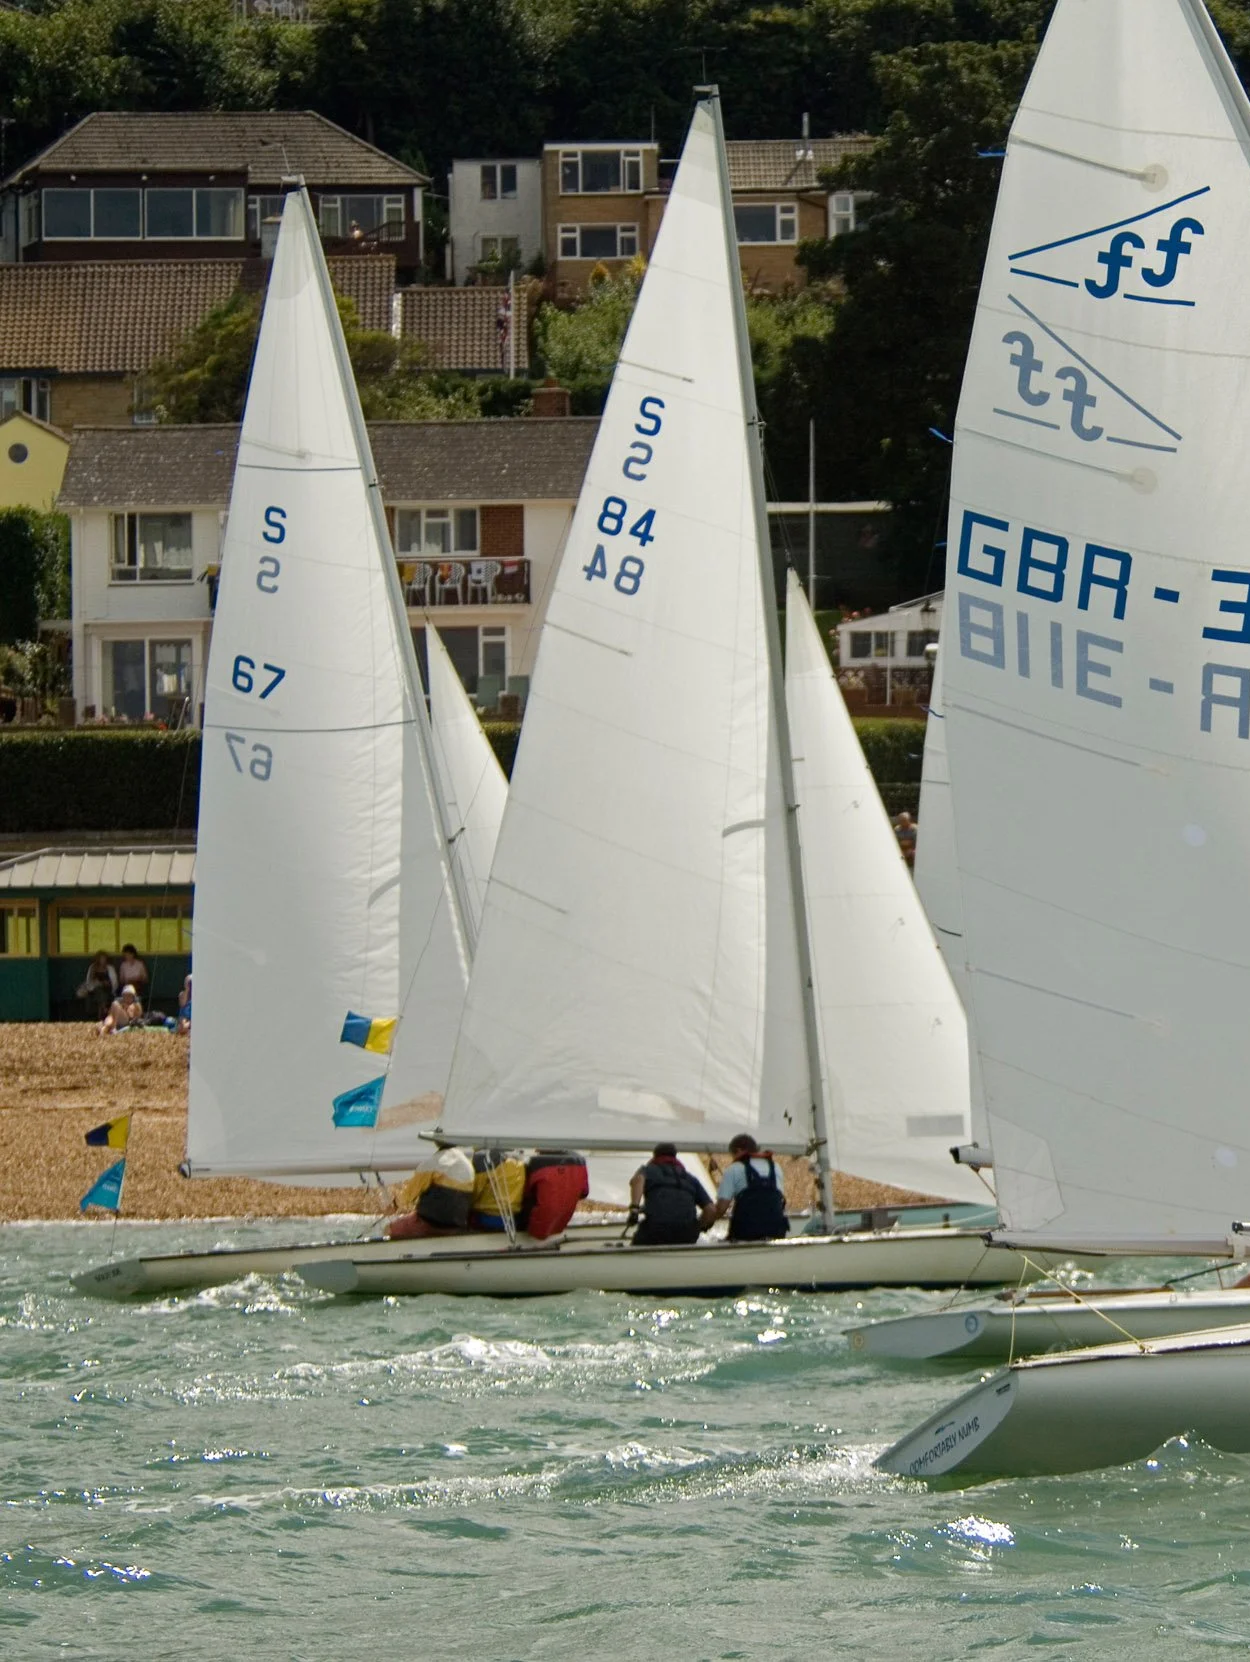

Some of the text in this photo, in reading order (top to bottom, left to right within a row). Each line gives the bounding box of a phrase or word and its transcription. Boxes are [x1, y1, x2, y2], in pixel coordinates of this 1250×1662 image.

[634, 396, 666, 436] S
[262, 505, 287, 544] S
[597, 495, 657, 548] 84
[231, 654, 287, 700] 67
